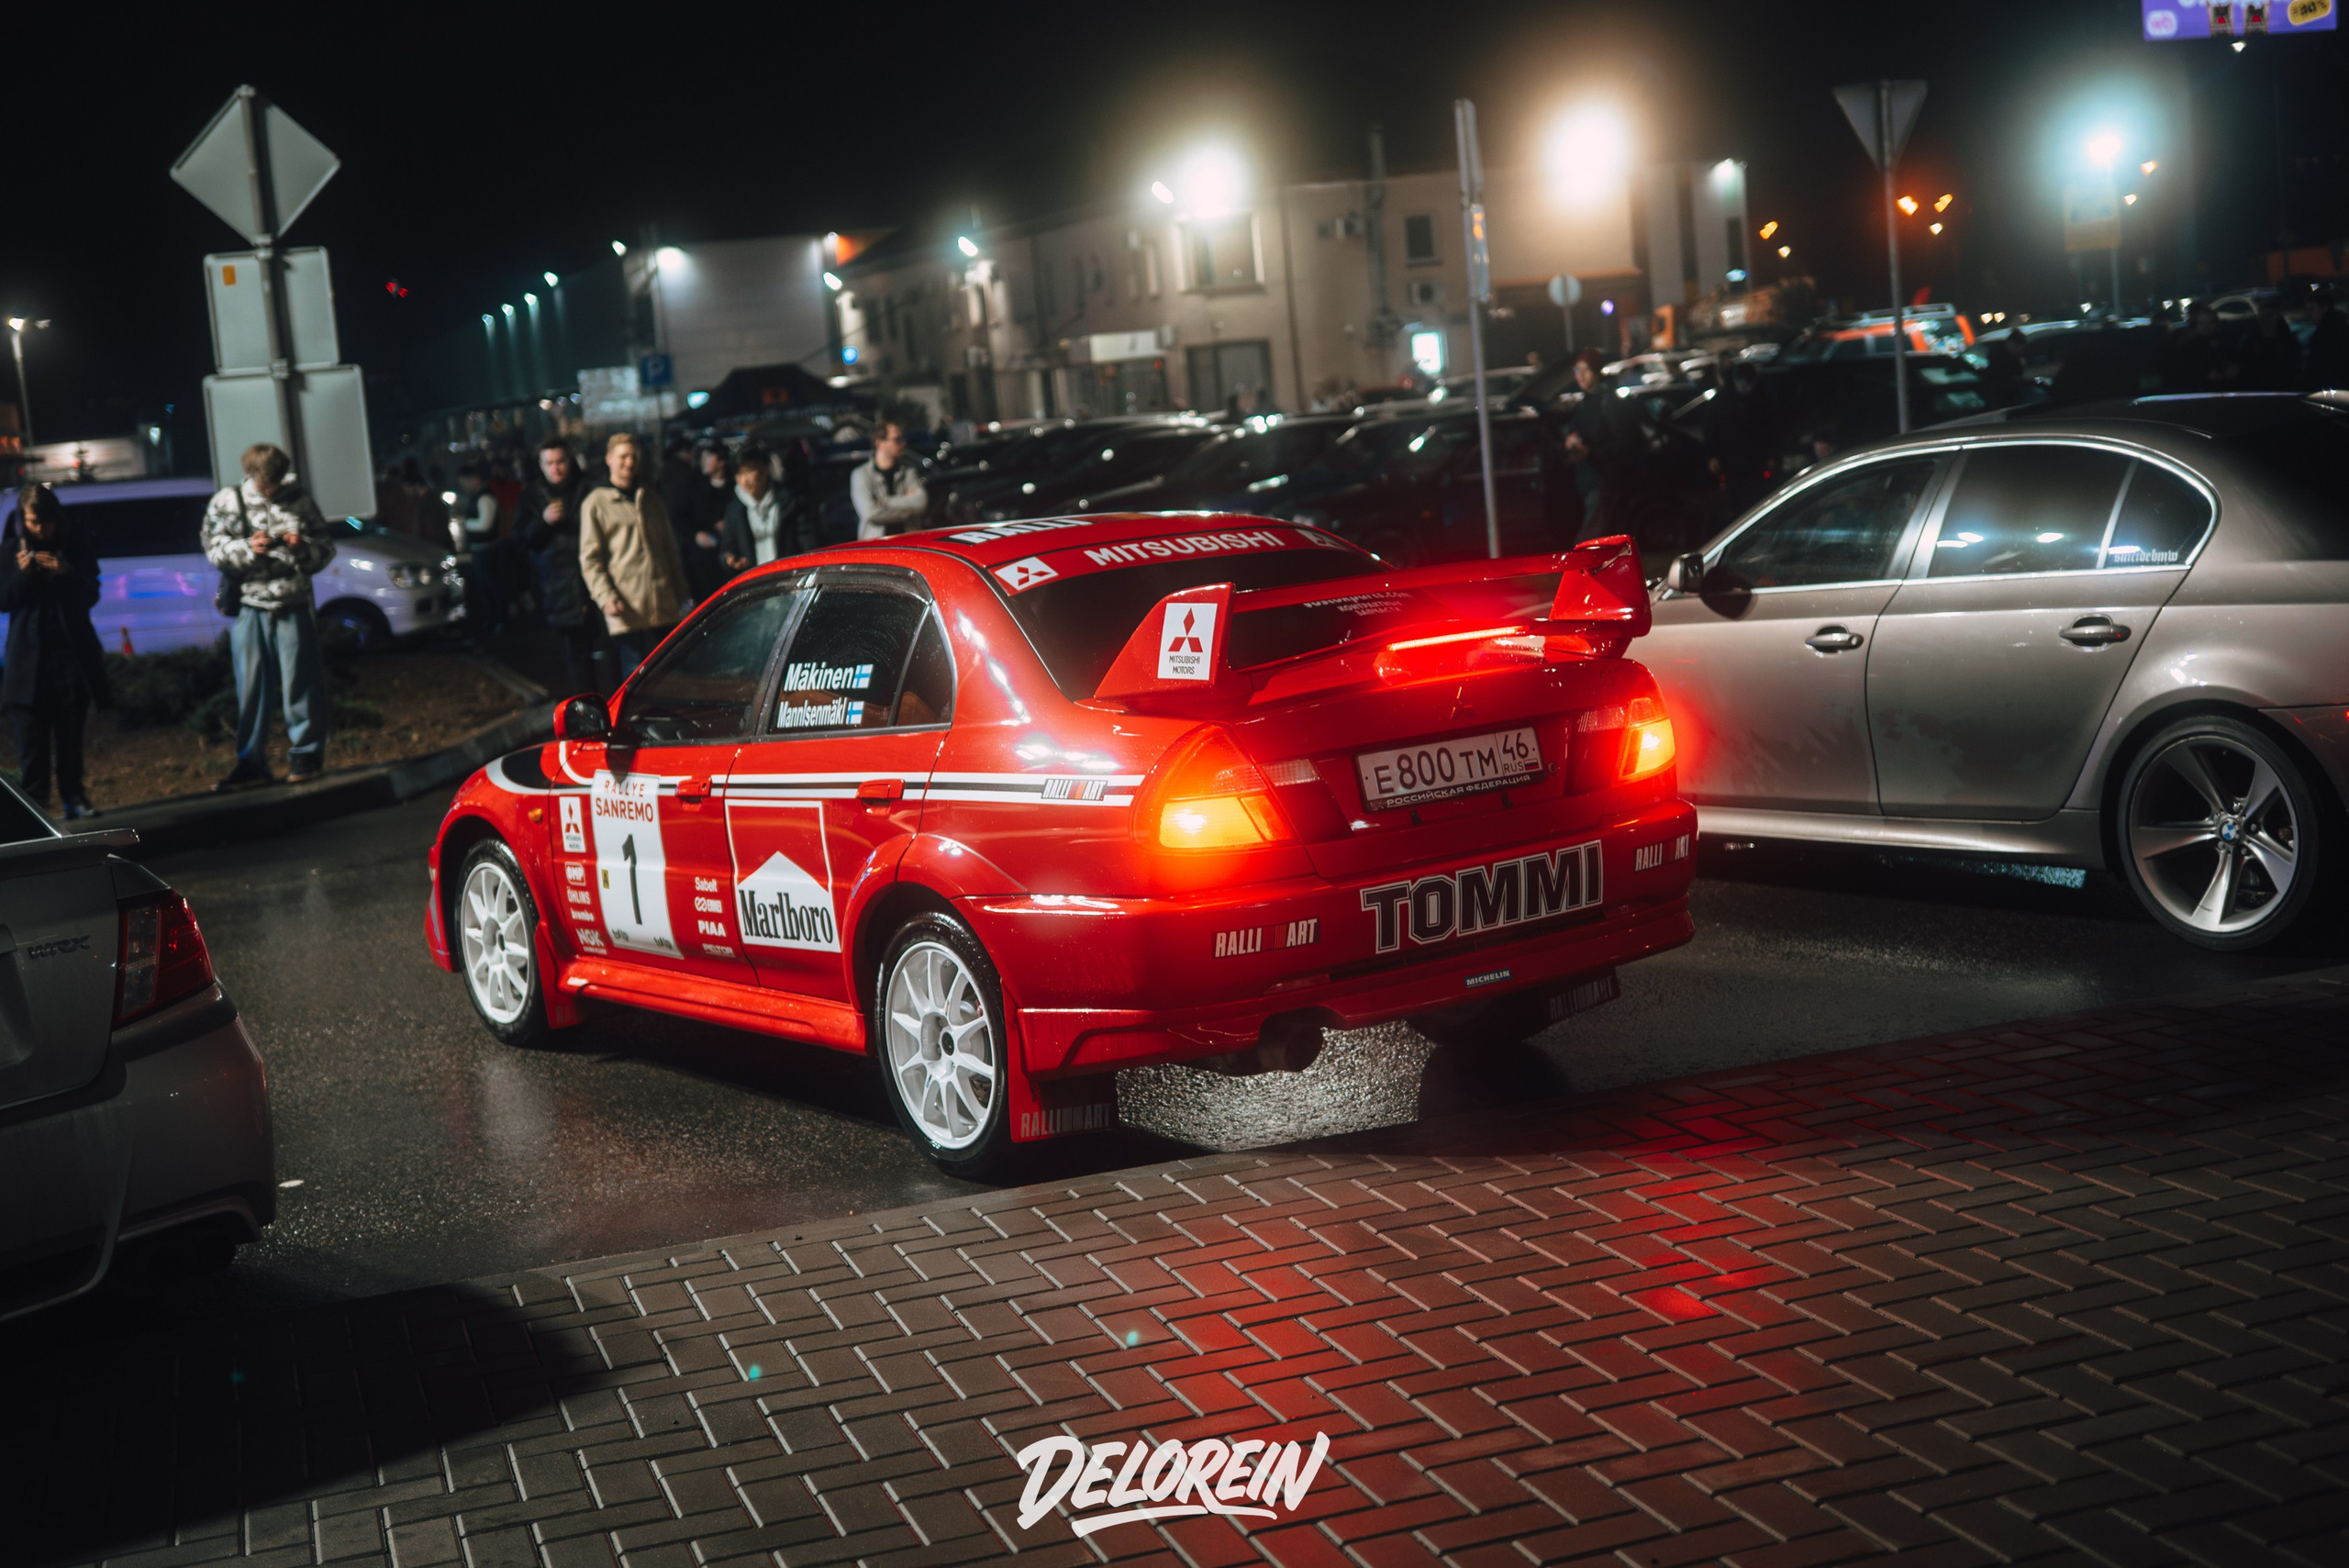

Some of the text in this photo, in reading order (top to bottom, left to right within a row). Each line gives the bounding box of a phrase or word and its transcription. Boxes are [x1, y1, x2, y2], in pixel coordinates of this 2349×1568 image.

[1084, 530, 1286, 567] MITSUBISHI
[1168, 654, 1201, 665] MITSUBISHI
[1172, 665, 1196, 675] MOTORS
[784, 662, 854, 692] Mäkinen
[1502, 732, 1530, 761] 46
[1503, 761, 1525, 773] RUS
[604, 780, 645, 797] RALLYE
[1386, 774, 1531, 806] РОССИЙСКАЯ ФЕДЕРАЦИЯ
[595, 796, 654, 823] SANREMO
[621, 833, 642, 926] 1
[695, 876, 718, 893] Sabelt
[1360, 840, 1604, 954] TOMMI
[697, 919, 728, 938] PIAA
[738, 889, 835, 945] Marlboro
[28, 934, 91, 961] WRX
[575, 927, 606, 948] NGK
[1465, 969, 1510, 986] MICHELIN
